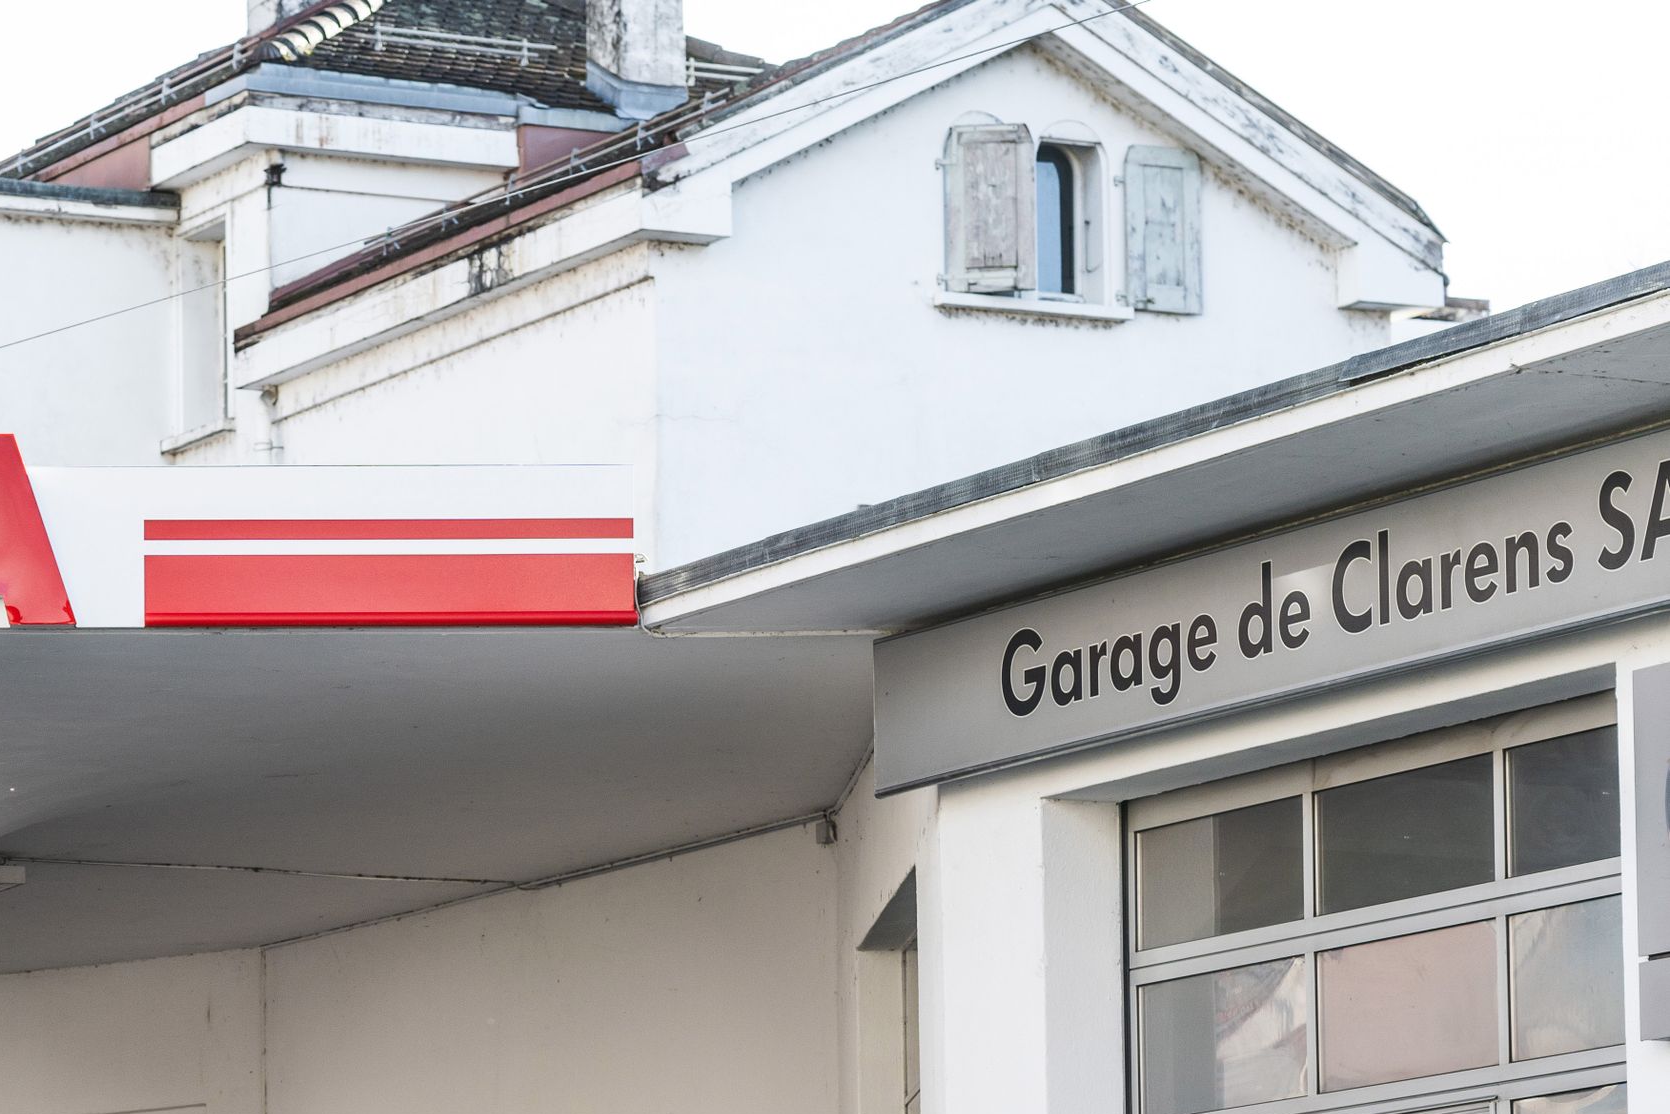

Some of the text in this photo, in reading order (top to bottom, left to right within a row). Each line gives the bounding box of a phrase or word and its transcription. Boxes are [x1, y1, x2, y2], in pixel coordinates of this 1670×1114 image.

[1001, 613, 1218, 717] Garage
[1237, 560, 1311, 660] de
[1331, 528, 1574, 635] Clarens
